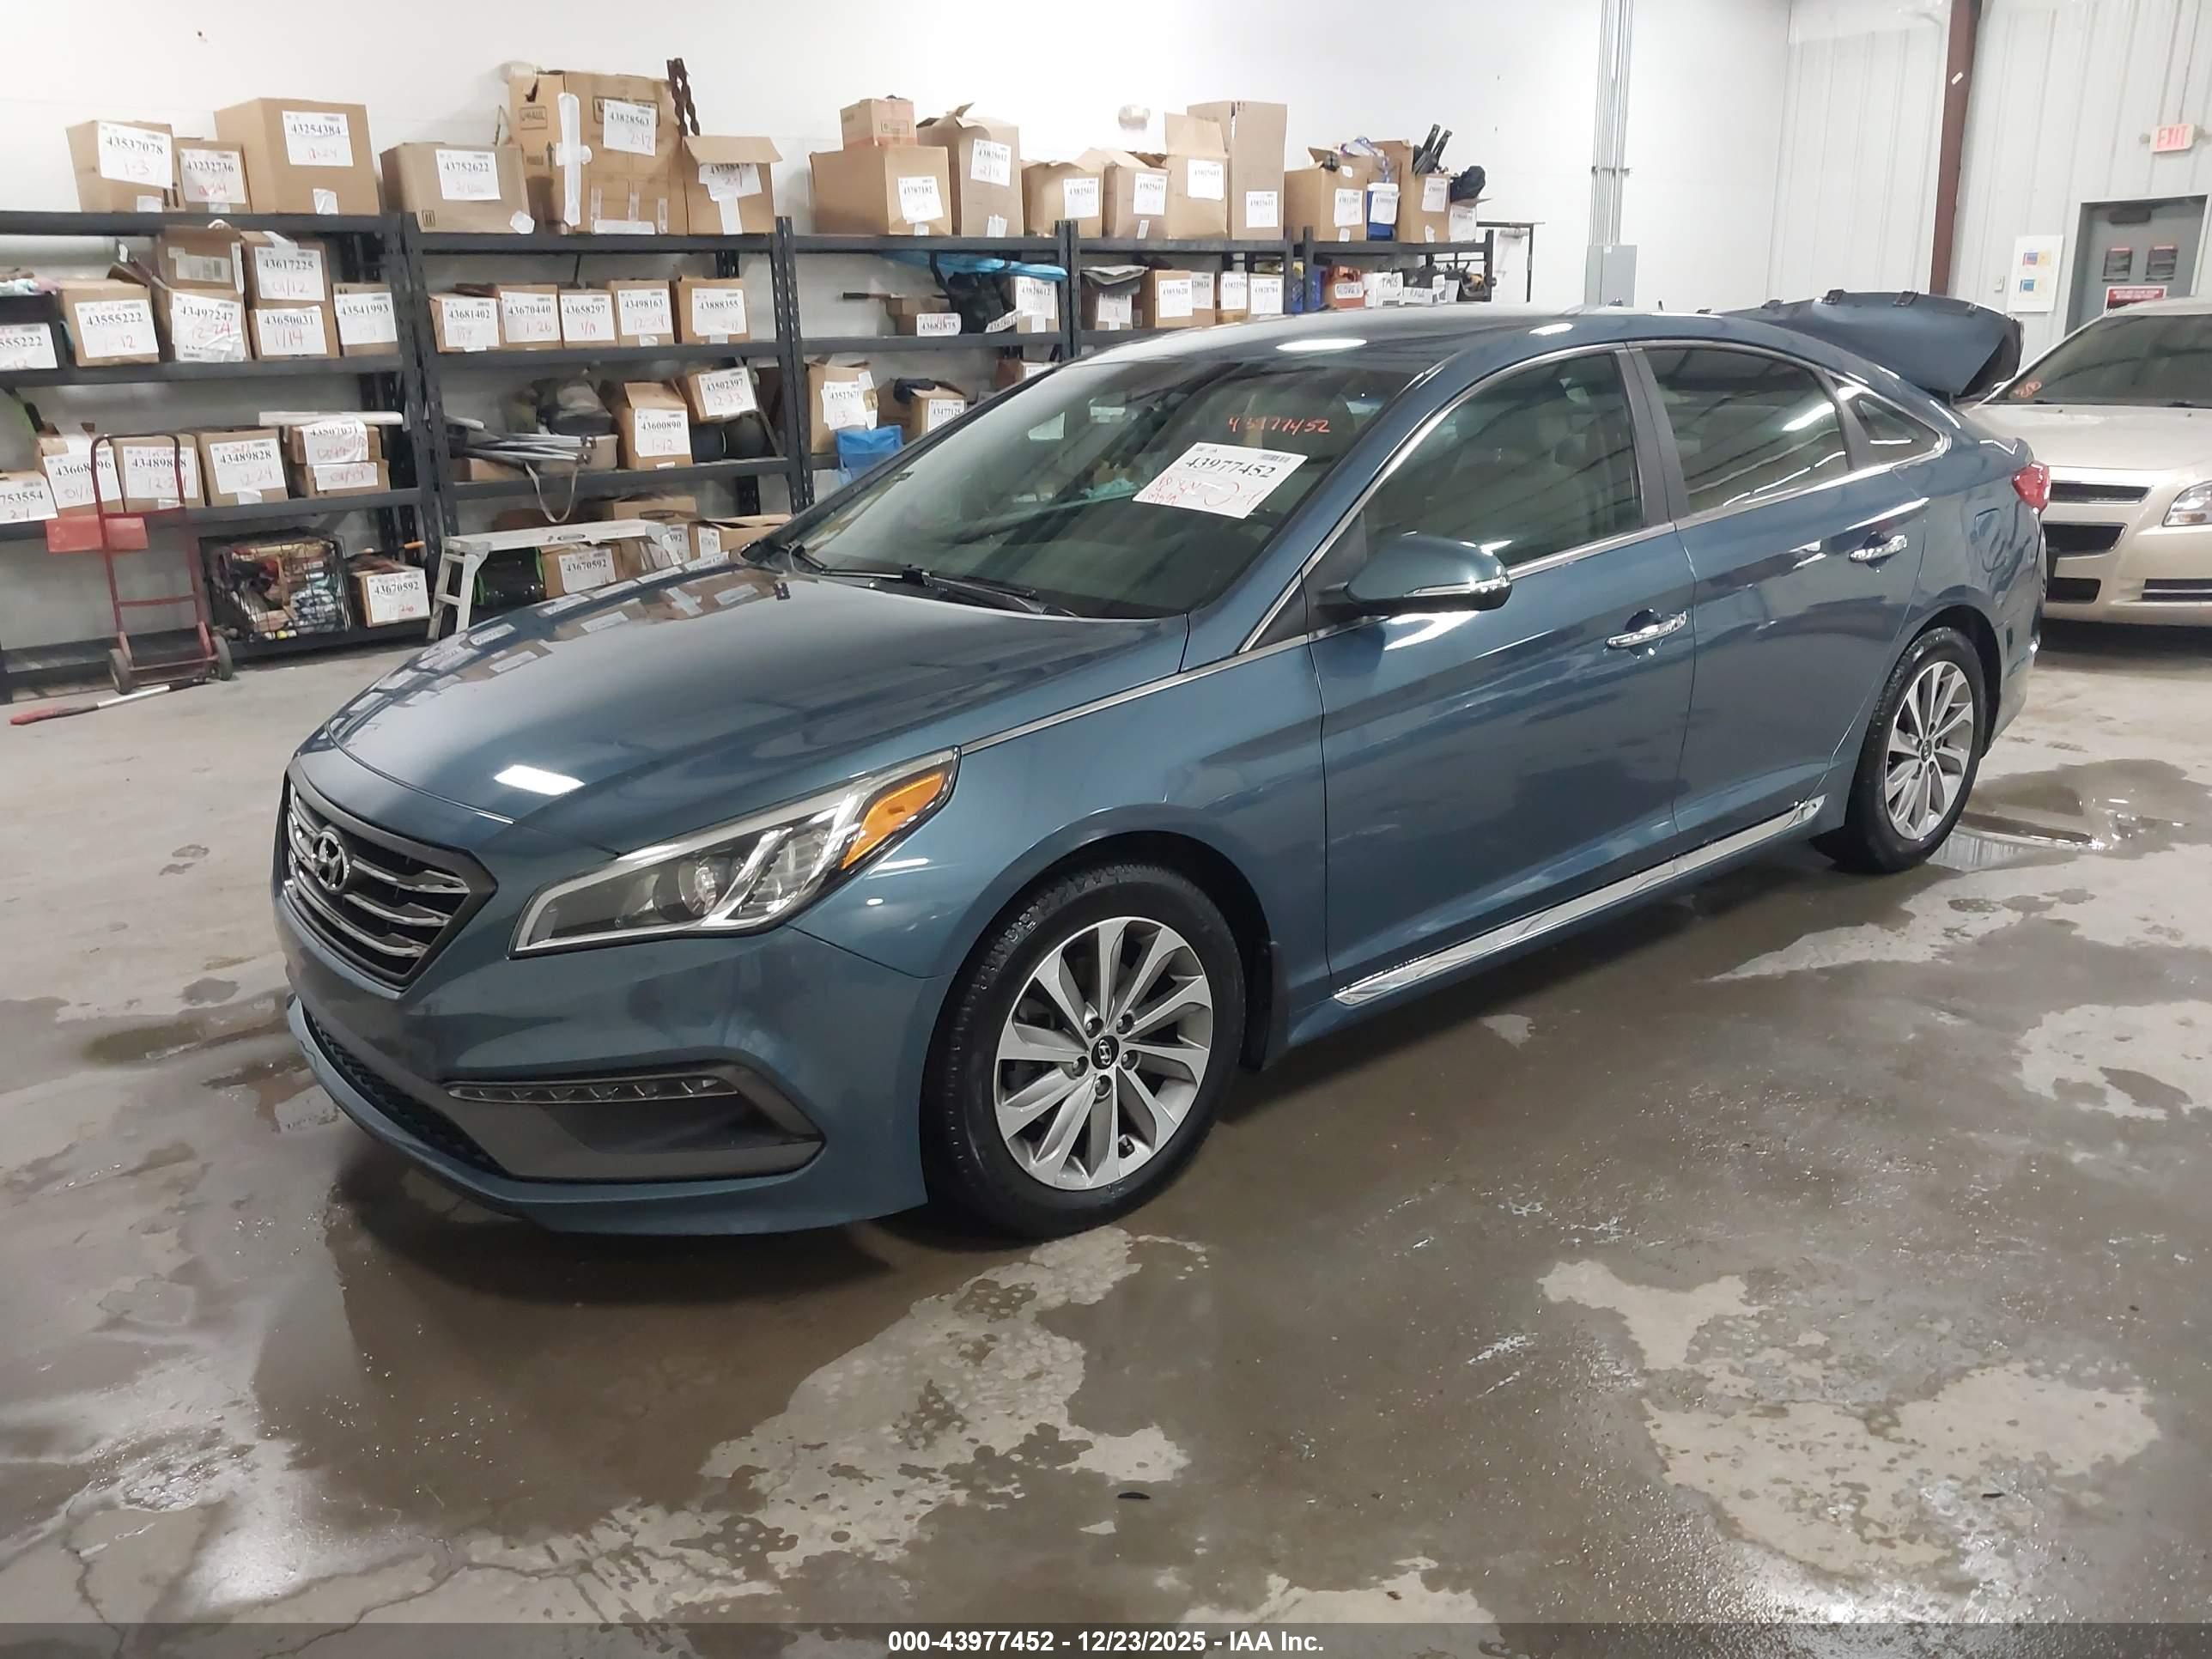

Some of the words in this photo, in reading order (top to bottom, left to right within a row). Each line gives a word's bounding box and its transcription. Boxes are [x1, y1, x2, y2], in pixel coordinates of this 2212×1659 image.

[2157, 127, 2189, 149] EXIT
[106, 136, 164, 155] 43537078
[263, 259, 314, 270] 43617225
[449, 308, 489, 319] 43681402
[508, 305, 551, 314] 43670440
[564, 304, 605, 314] 43658297
[87, 312, 143, 325] 43555222
[641, 421, 681, 430] 43600890
[131, 457, 187, 468] 4348988
[220, 450, 272, 465] 43489828
[56, 460, 112, 477] 4366896
[1186, 457, 1277, 478] 43977452
[567, 558, 607, 572] 43670592
[374, 581, 420, 595] 43670592
